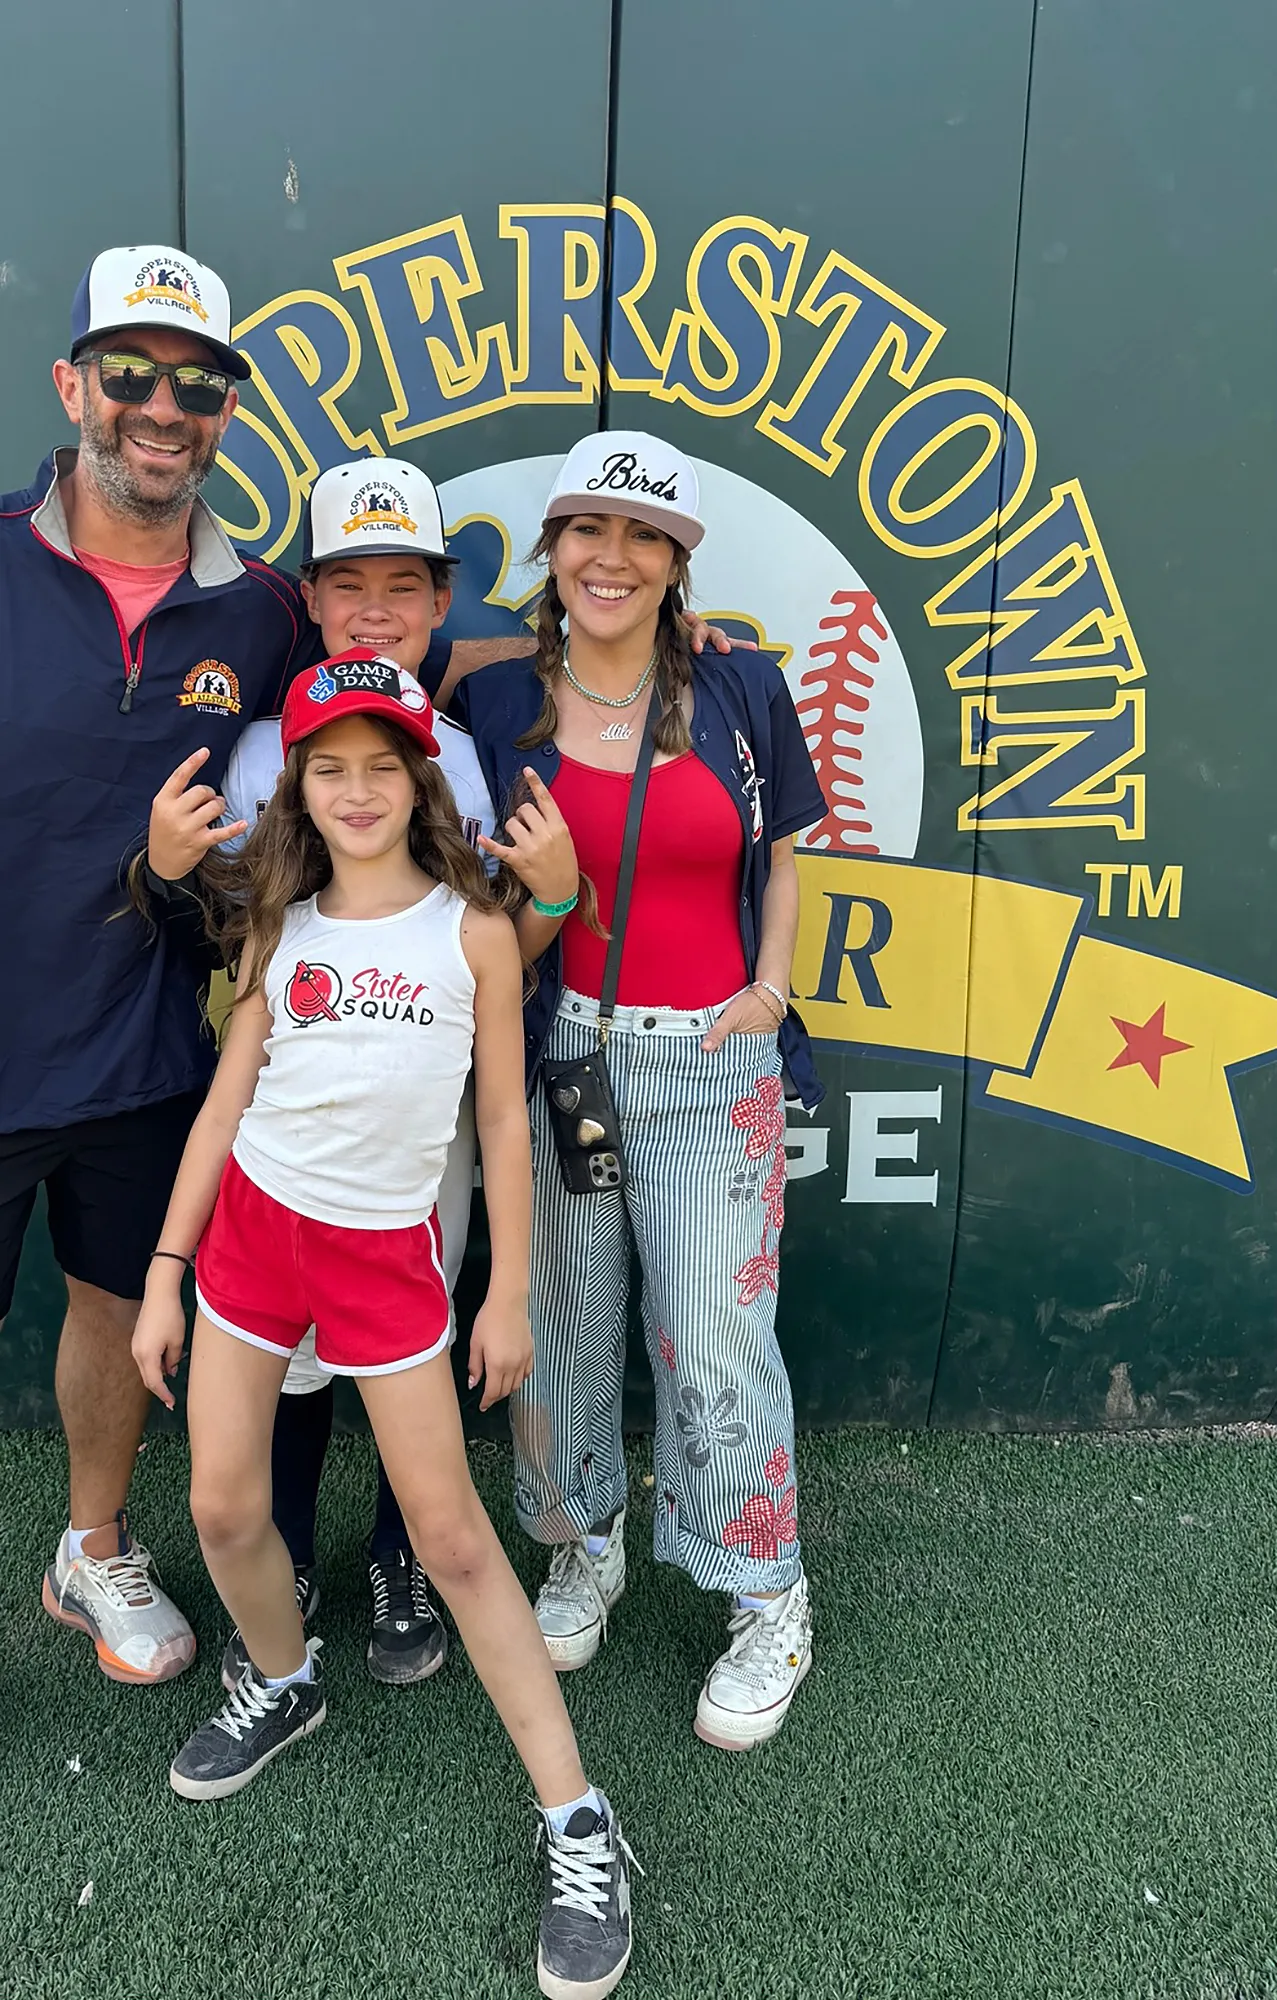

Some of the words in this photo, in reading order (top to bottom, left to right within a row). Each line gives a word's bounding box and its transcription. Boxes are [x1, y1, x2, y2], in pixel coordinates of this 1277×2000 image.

[134, 257, 202, 301] COOPERSTOWN
[147, 297, 192, 315] VILLAGE
[586, 453, 678, 501] Birds
[349, 481, 409, 516] COOPERSTOWN
[214, 196, 1148, 840] OPERSTOWN
[361, 523, 402, 532] VILLAGE
[334, 663, 392, 680] GAME
[343, 675, 386, 689] DAY
[195, 704, 229, 716] VILLAGE
[1085, 863, 1183, 918] TM
[350, 967, 430, 1003] Sister
[342, 999, 434, 1026] SQUAD
